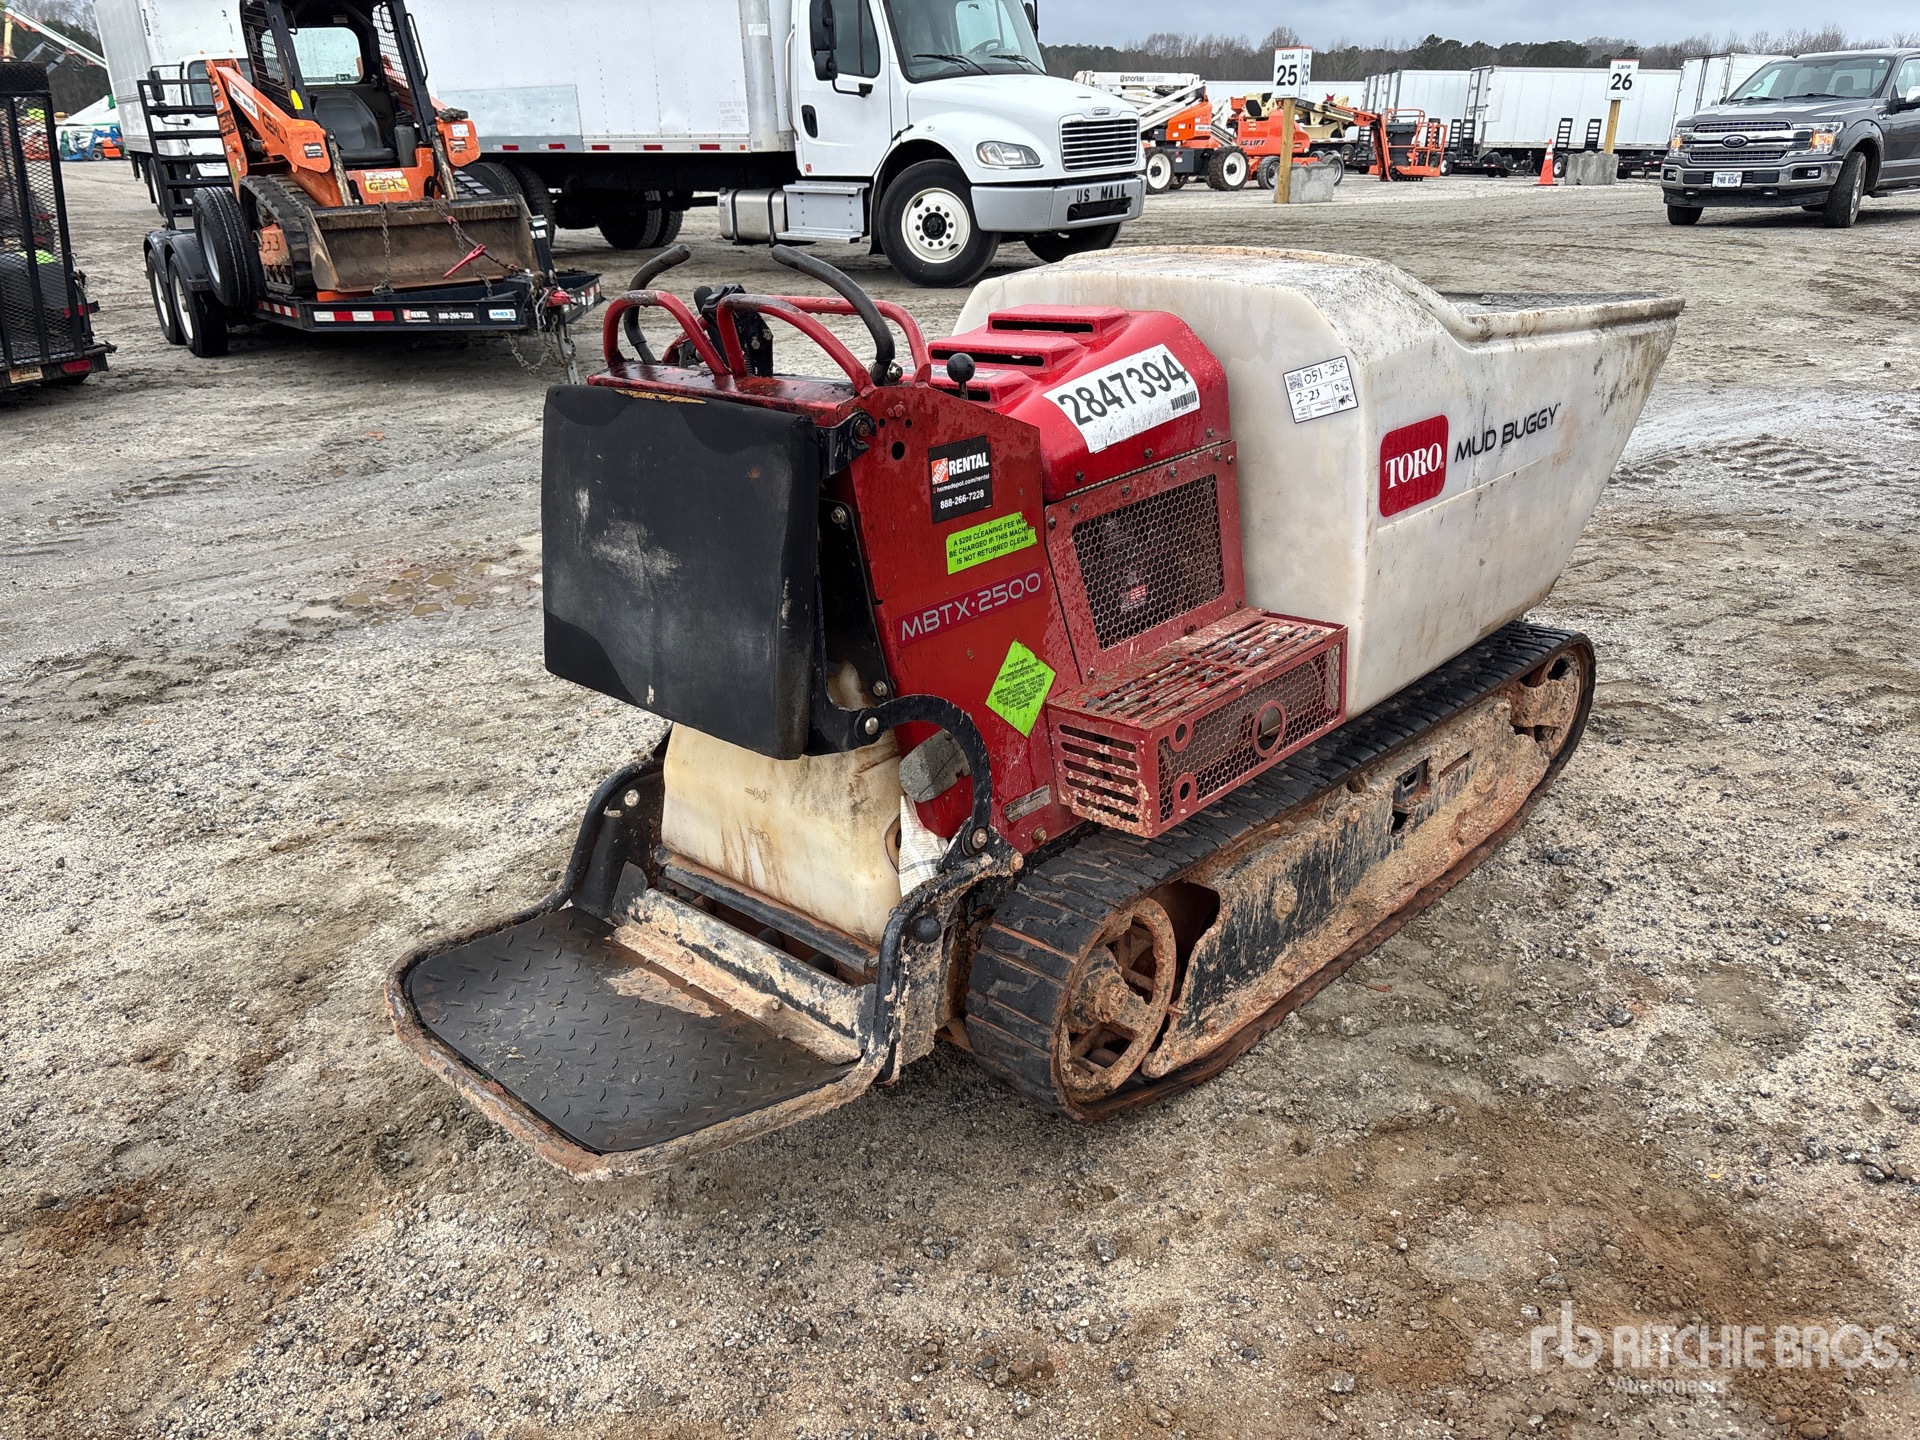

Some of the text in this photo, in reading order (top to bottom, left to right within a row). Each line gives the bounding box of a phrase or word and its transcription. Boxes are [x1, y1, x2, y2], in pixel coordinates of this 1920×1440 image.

[1276, 64, 1297, 86] 25
[1610, 73, 1632, 91] 26
[1077, 184, 1126, 203] US MAIL
[1058, 354, 1189, 426] 2847394
[1455, 403, 1558, 463] MUD BUGGY
[948, 451, 989, 476] RENTAL
[1385, 442, 1442, 489] TORO
[936, 473, 990, 493] homedepot.com/rental
[940, 489, 985, 509] 888-266-7228
[973, 524, 1003, 540] CLEANING
[1004, 520, 1014, 530] FEE
[948, 549, 957, 558] BE
[958, 540, 987, 554] CHARGED
[995, 532, 1008, 541] THIS
[956, 535, 1029, 565] IS NOT RETURNED CLEAN
